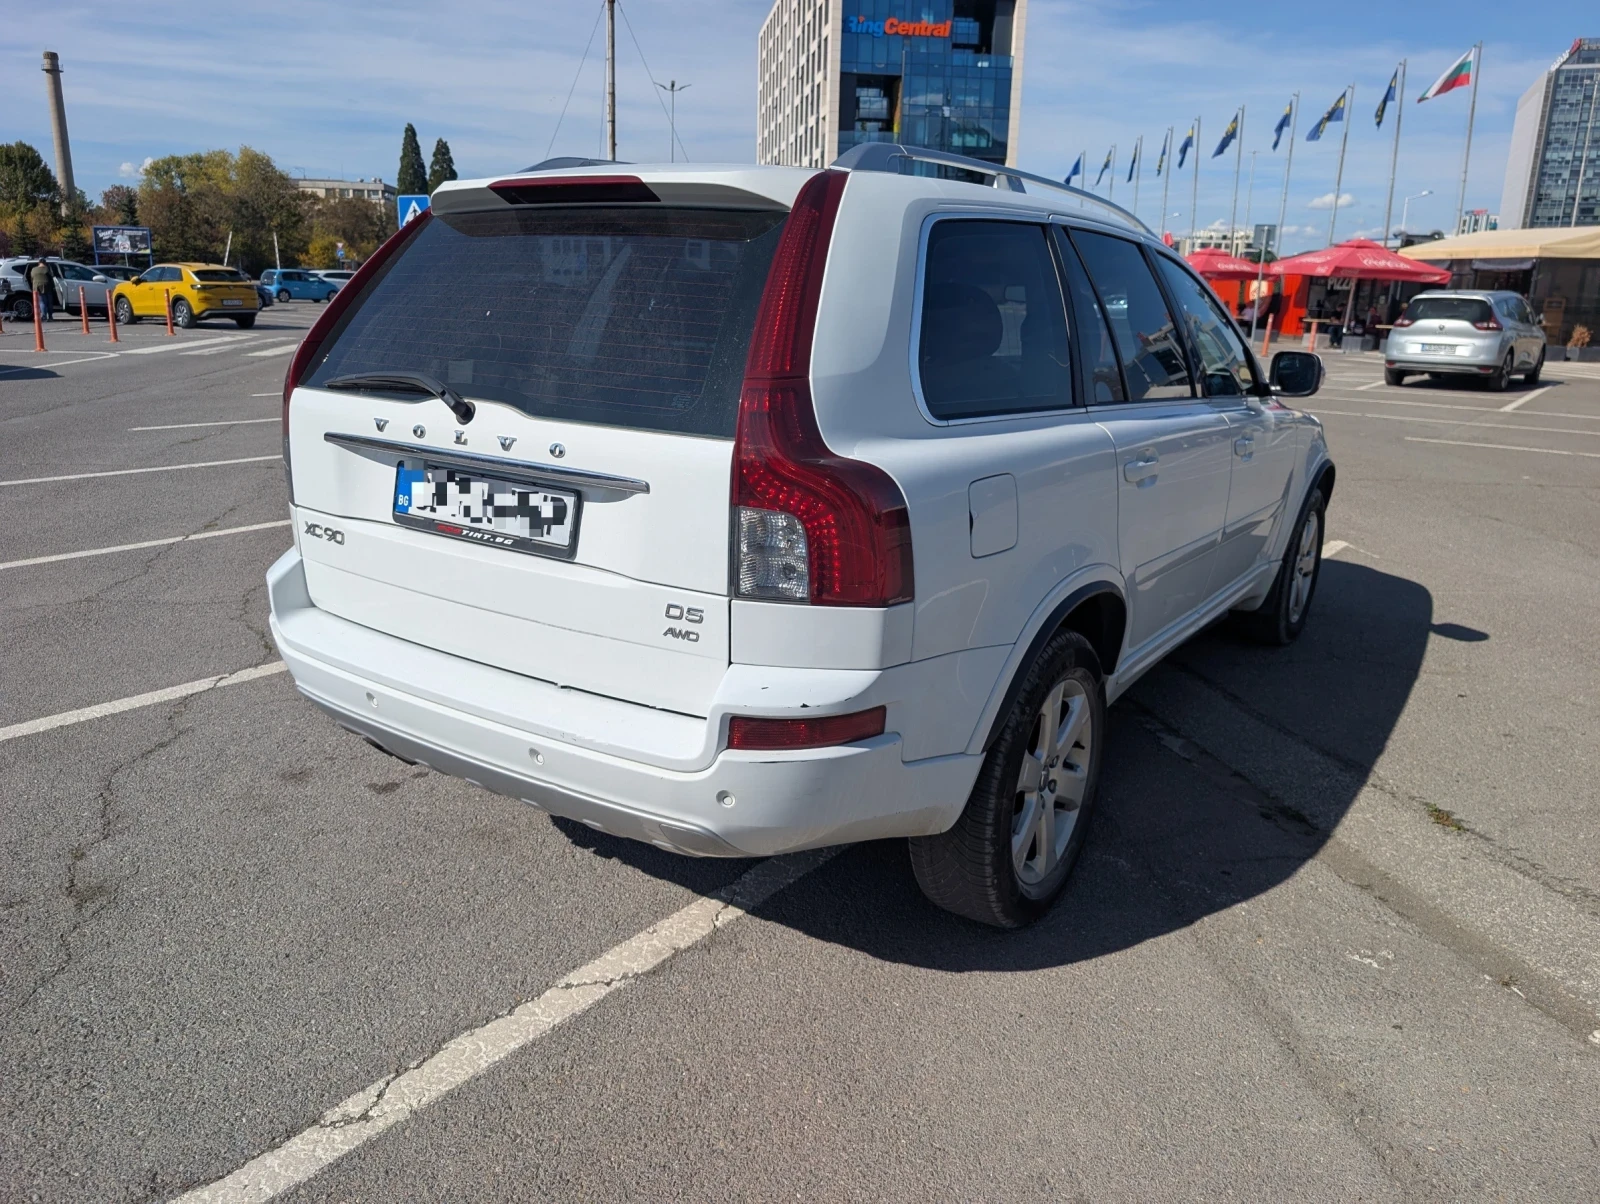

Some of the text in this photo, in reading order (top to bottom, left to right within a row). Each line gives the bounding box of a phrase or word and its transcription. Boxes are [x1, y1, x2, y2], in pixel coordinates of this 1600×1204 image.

[847, 16, 952, 37] RingCentral
[374, 417, 566, 458] VOLVO
[397, 494, 409, 507] BG
[304, 521, 345, 545] XC90
[437, 524, 514, 545] TINT.BG
[665, 602, 705, 624] D5
[662, 626, 700, 642] AWD
